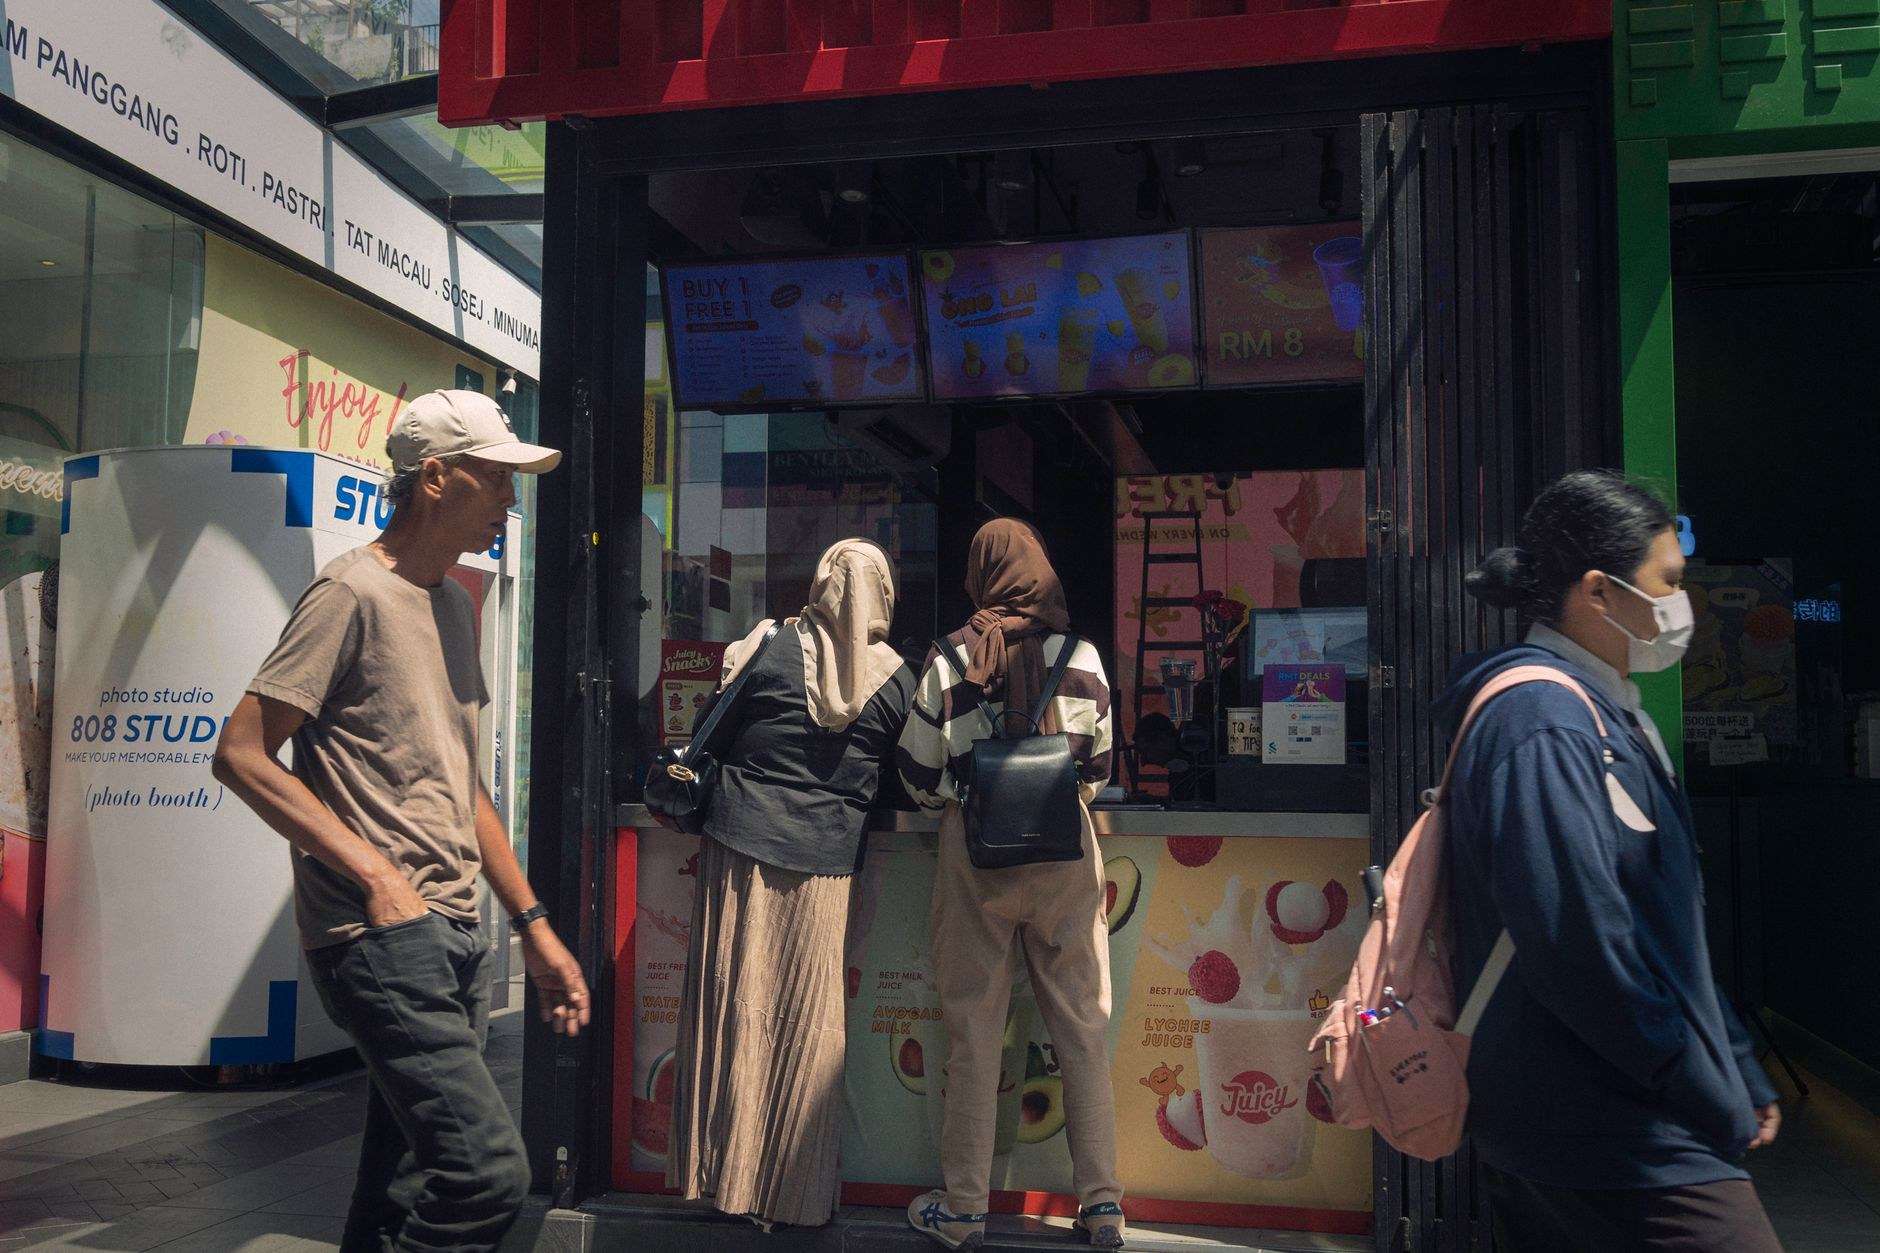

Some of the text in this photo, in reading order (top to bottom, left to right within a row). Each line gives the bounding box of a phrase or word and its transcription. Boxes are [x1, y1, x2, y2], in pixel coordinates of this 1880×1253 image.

[37, 36, 179, 146] PANGGANG
[198, 132, 246, 186] ROTI
[262, 171, 326, 232] PASTRI
[344, 219, 373, 257] TAT
[377, 238, 431, 290] MACAU
[442, 277, 484, 321] SOSEJ
[493, 307, 540, 352] MINUMA
[682, 278, 729, 298] BUY
[685, 300, 735, 319] FREE
[1219, 327, 1304, 360] RM 8
[279, 349, 381, 452] Enjoy
[663, 656, 711, 672] Snacks
[1299, 672, 1330, 681] DEALS
[100, 686, 214, 707] photo studio
[71, 715, 118, 743] 808
[65, 752, 87, 763] MAKE
[89, 752, 117, 763] YOUR
[118, 752, 199, 764] MEMORABLE
[494, 730, 502, 788] STUDIO
[647, 962, 667, 970] BEST
[879, 971, 923, 981] BEST MILK
[877, 981, 902, 990] JUICE
[1150, 986, 1172, 996] BEST
[871, 1021, 912, 1035] MILK
[1144, 1018, 1211, 1034] LYCHEE
[1142, 1033, 1194, 1049] JUICE
[1220, 1081, 1299, 1117] Juicy
